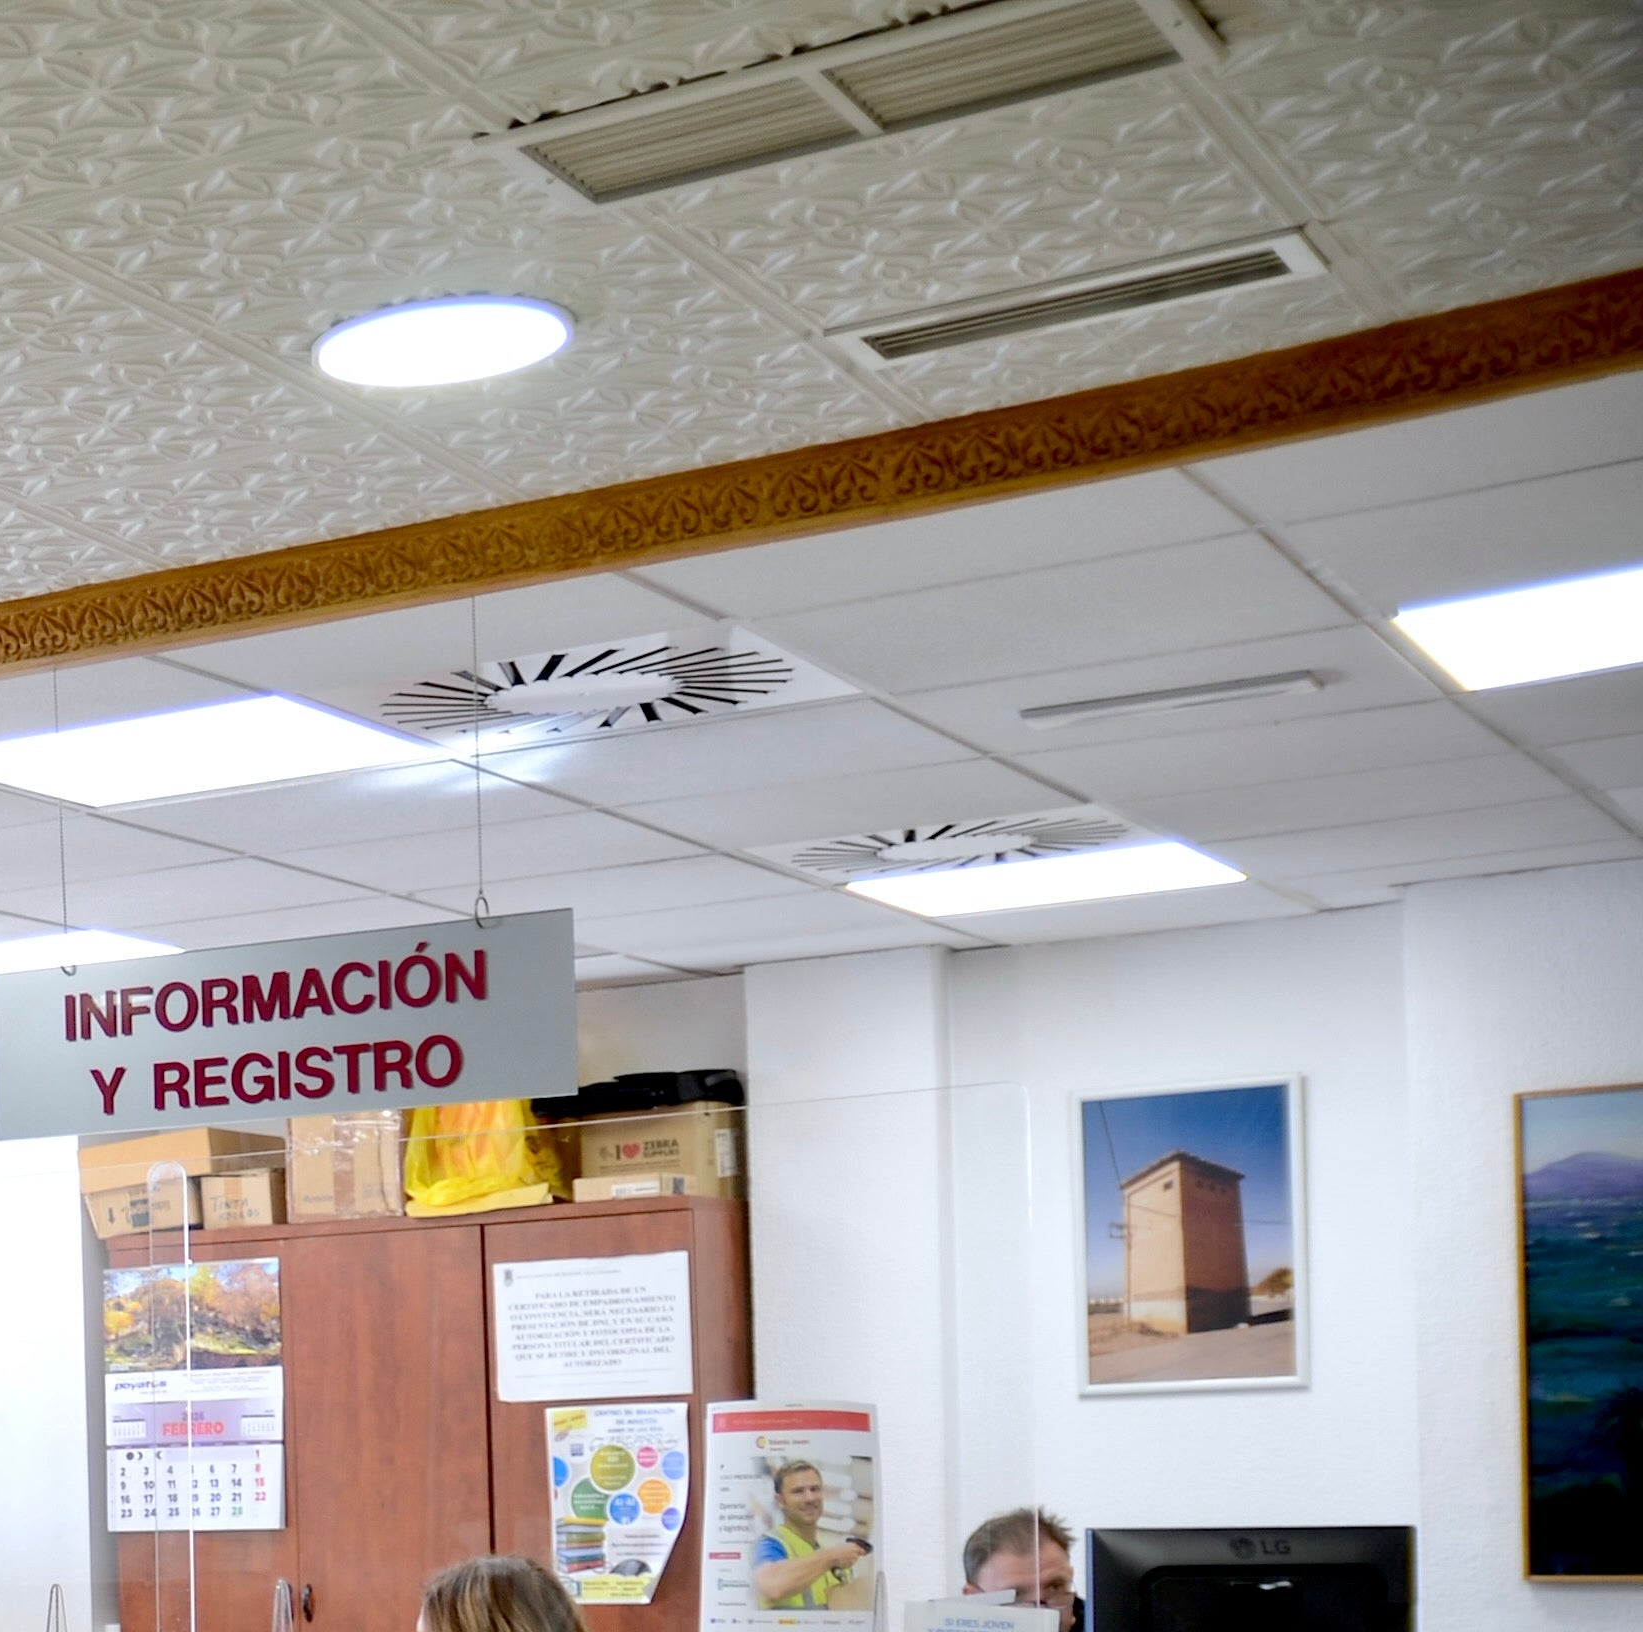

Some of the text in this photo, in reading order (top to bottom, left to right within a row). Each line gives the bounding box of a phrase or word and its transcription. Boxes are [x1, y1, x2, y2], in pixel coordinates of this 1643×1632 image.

[63, 941, 488, 1042] INFORMACIÓN
[89, 1034, 463, 1117] Y REGISTRO
[534, 1292, 557, 1300] PARA
[572, 1288, 618, 1298] RETIRADA
[507, 1301, 568, 1312] CERTIFICADO
[583, 1294, 677, 1307] EMPADRONAMIENTO
[511, 1341, 552, 1351] PERSONA
[612, 1335, 675, 1346] CERTIFICADO
[119, 1467, 126, 1477] 2
[143, 1480, 156, 1490] 10
[167, 1479, 177, 1489] 11
[231, 1478, 242, 1488] 14
[143, 1494, 154, 1504] 17
[209, 1492, 222, 1503] 20
[231, 1492, 242, 1502] 21
[255, 1491, 266, 1502] 22
[120, 1508, 133, 1518] 23
[143, 1508, 157, 1518] 24
[210, 1506, 221, 1516] 27
[1260, 1540, 1292, 1555] LG
[956, 1618, 980, 1628] ERES
[983, 1620, 1014, 1629] JOVEN
